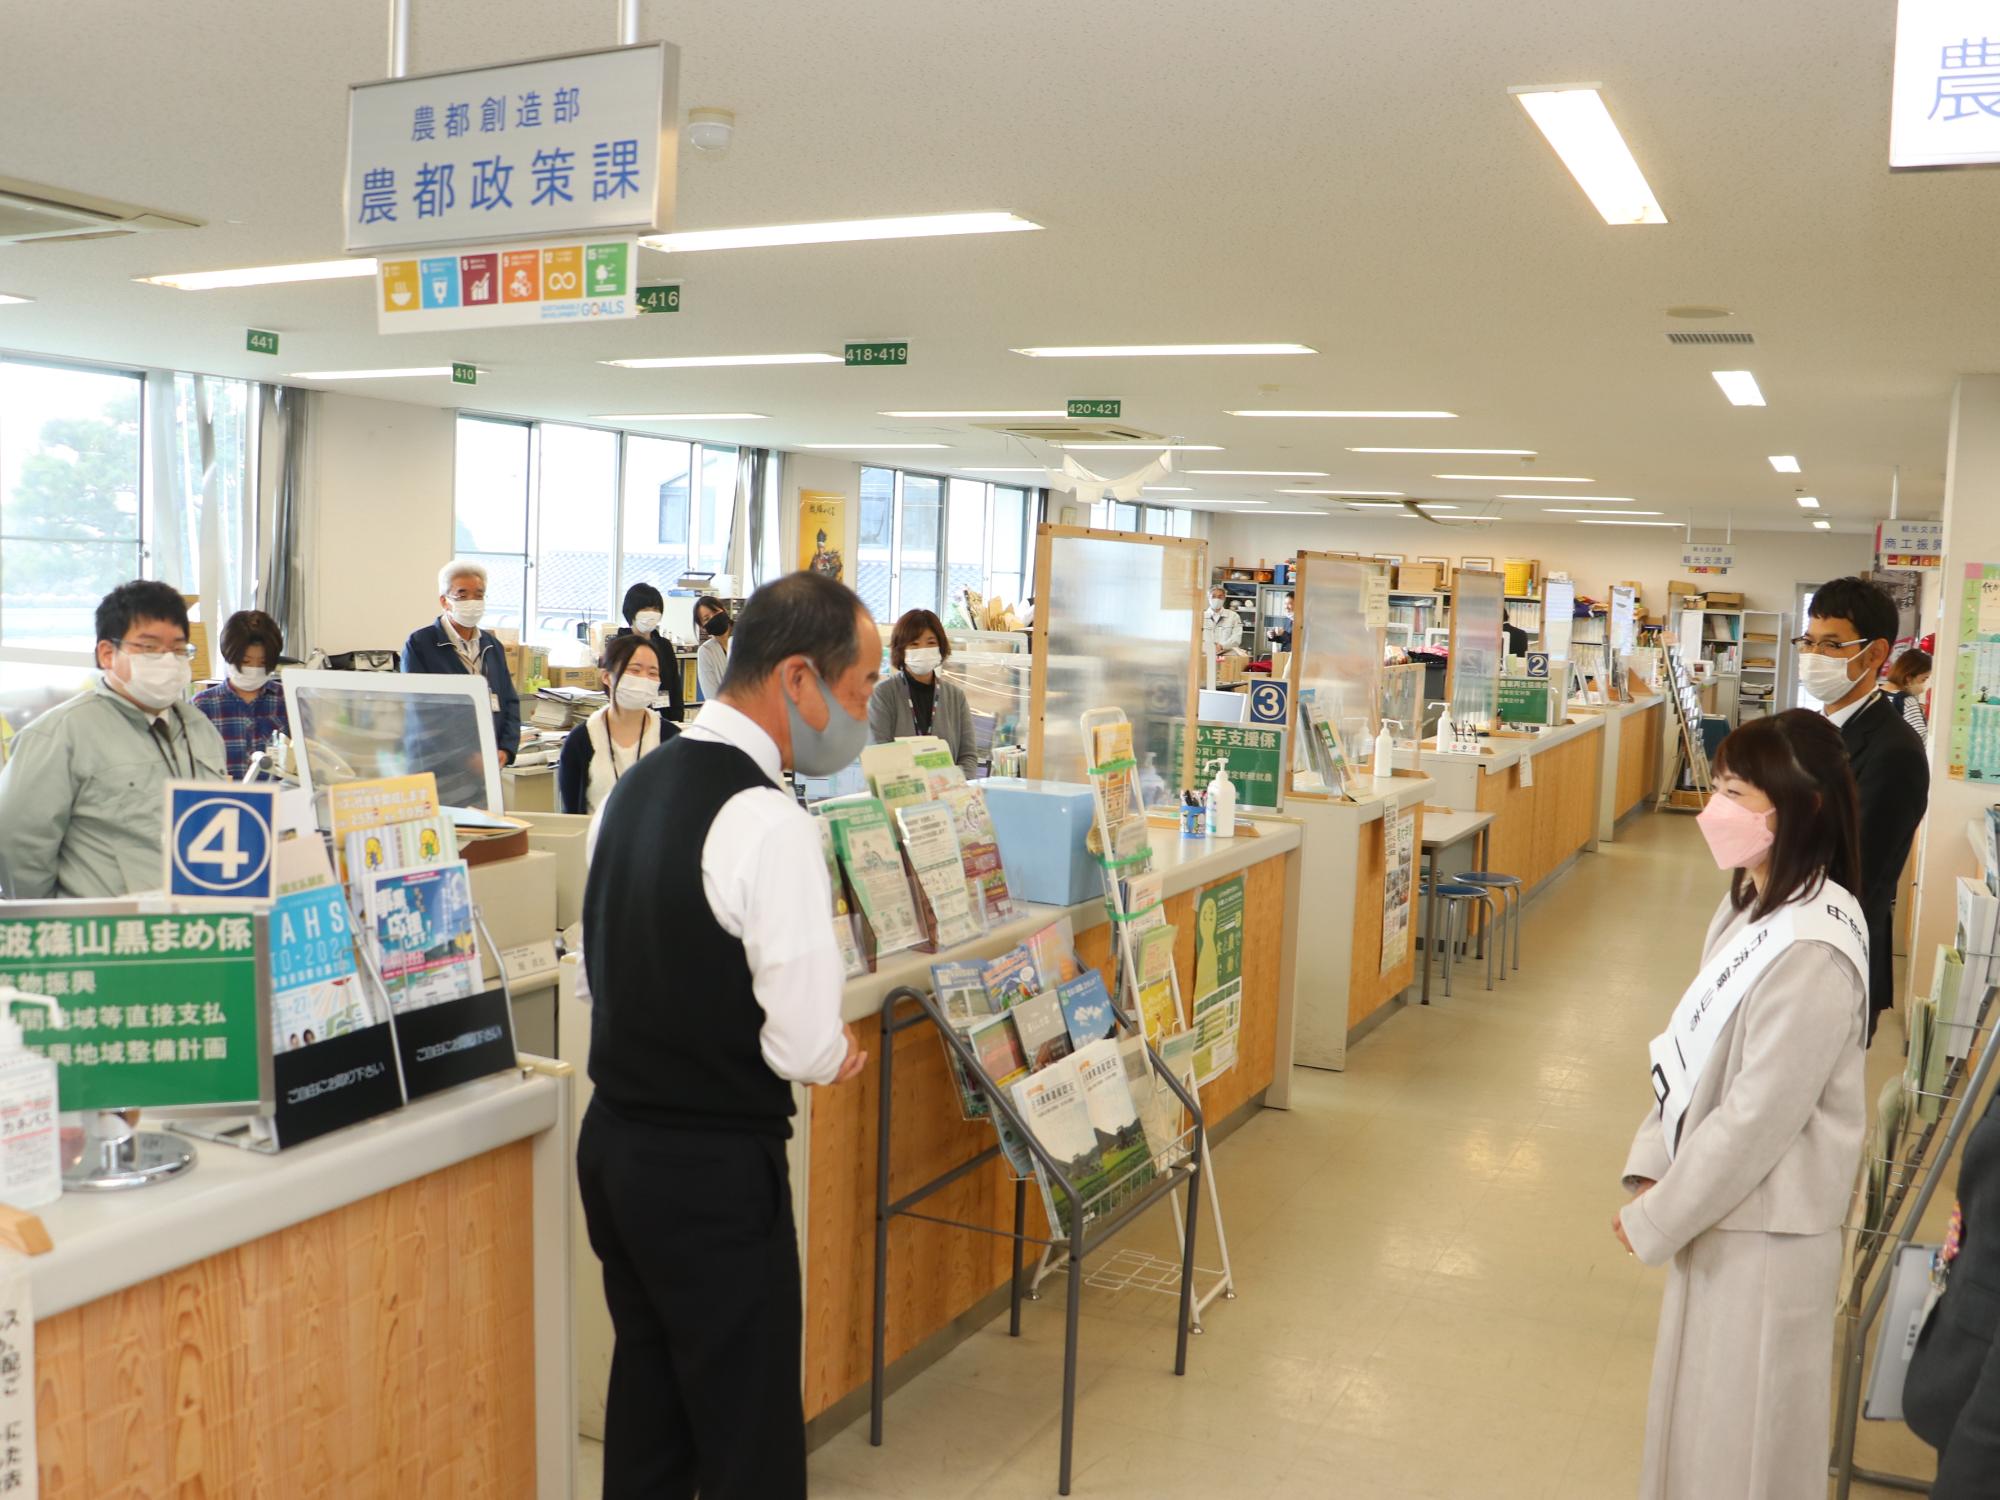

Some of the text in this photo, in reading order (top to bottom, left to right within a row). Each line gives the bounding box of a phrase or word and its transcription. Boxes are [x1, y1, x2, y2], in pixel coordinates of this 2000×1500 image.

[411, 86, 581, 142] 農都創造部
[357, 138, 641, 225] 農都政策課
[250, 334, 274, 350] 441
[455, 367, 474, 381] 410
[1902, 525, 1942, 534] 観光交流
[1531, 656, 1545, 673] 2
[1258, 687, 1280, 716] 3
[186, 807, 250, 880] 4
